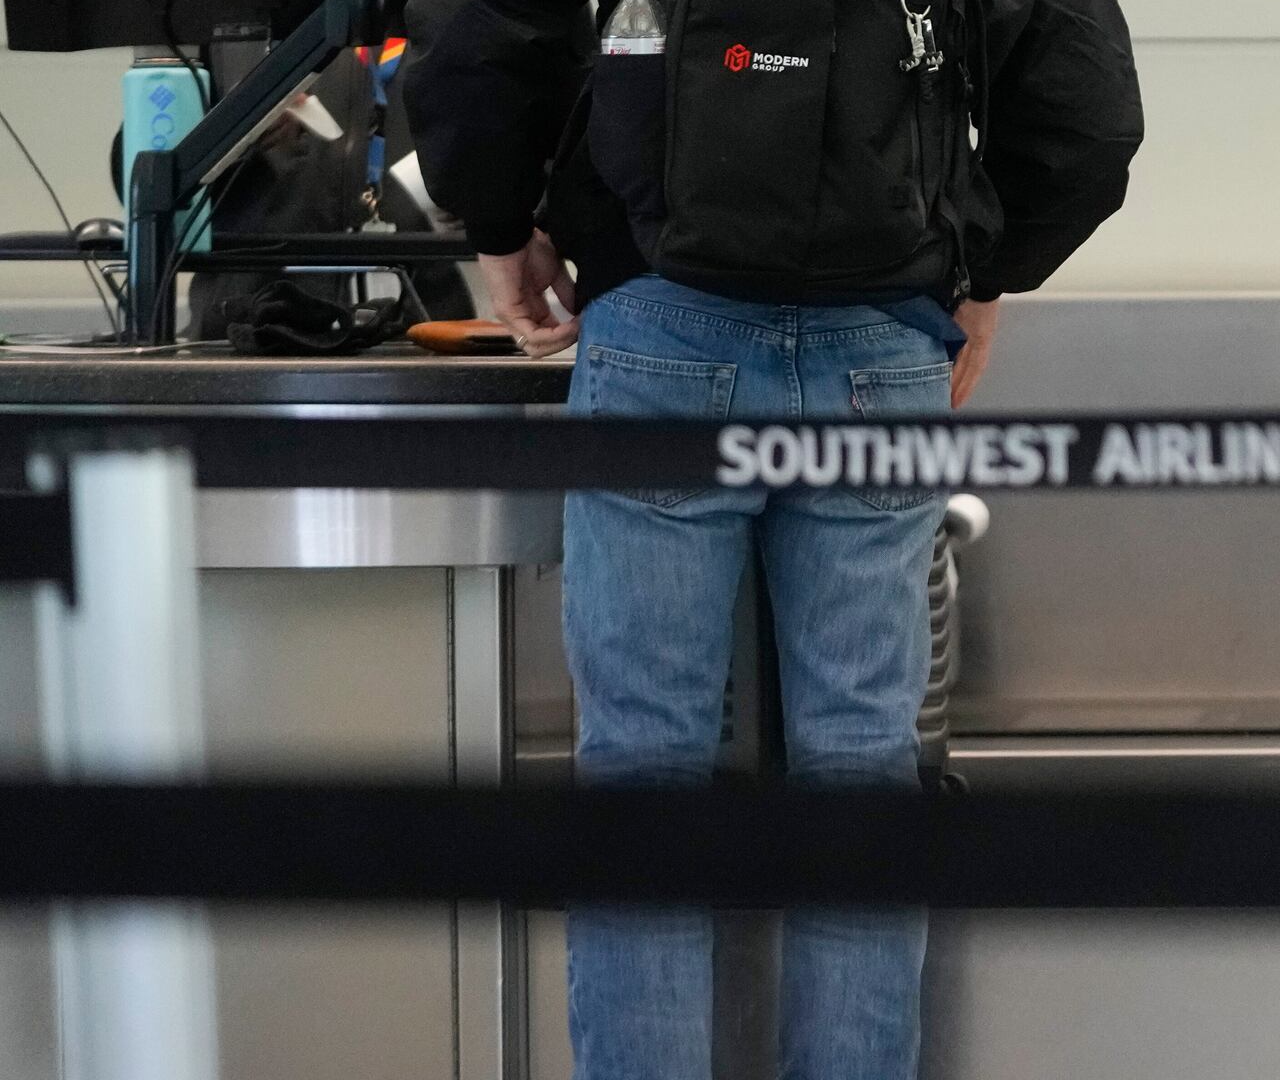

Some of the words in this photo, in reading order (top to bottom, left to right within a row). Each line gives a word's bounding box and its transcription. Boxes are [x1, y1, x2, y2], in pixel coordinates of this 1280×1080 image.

[752, 63, 785, 72] GROUP
[753, 52, 810, 68] MODERN
[716, 423, 1079, 488] SOUTHWEST
